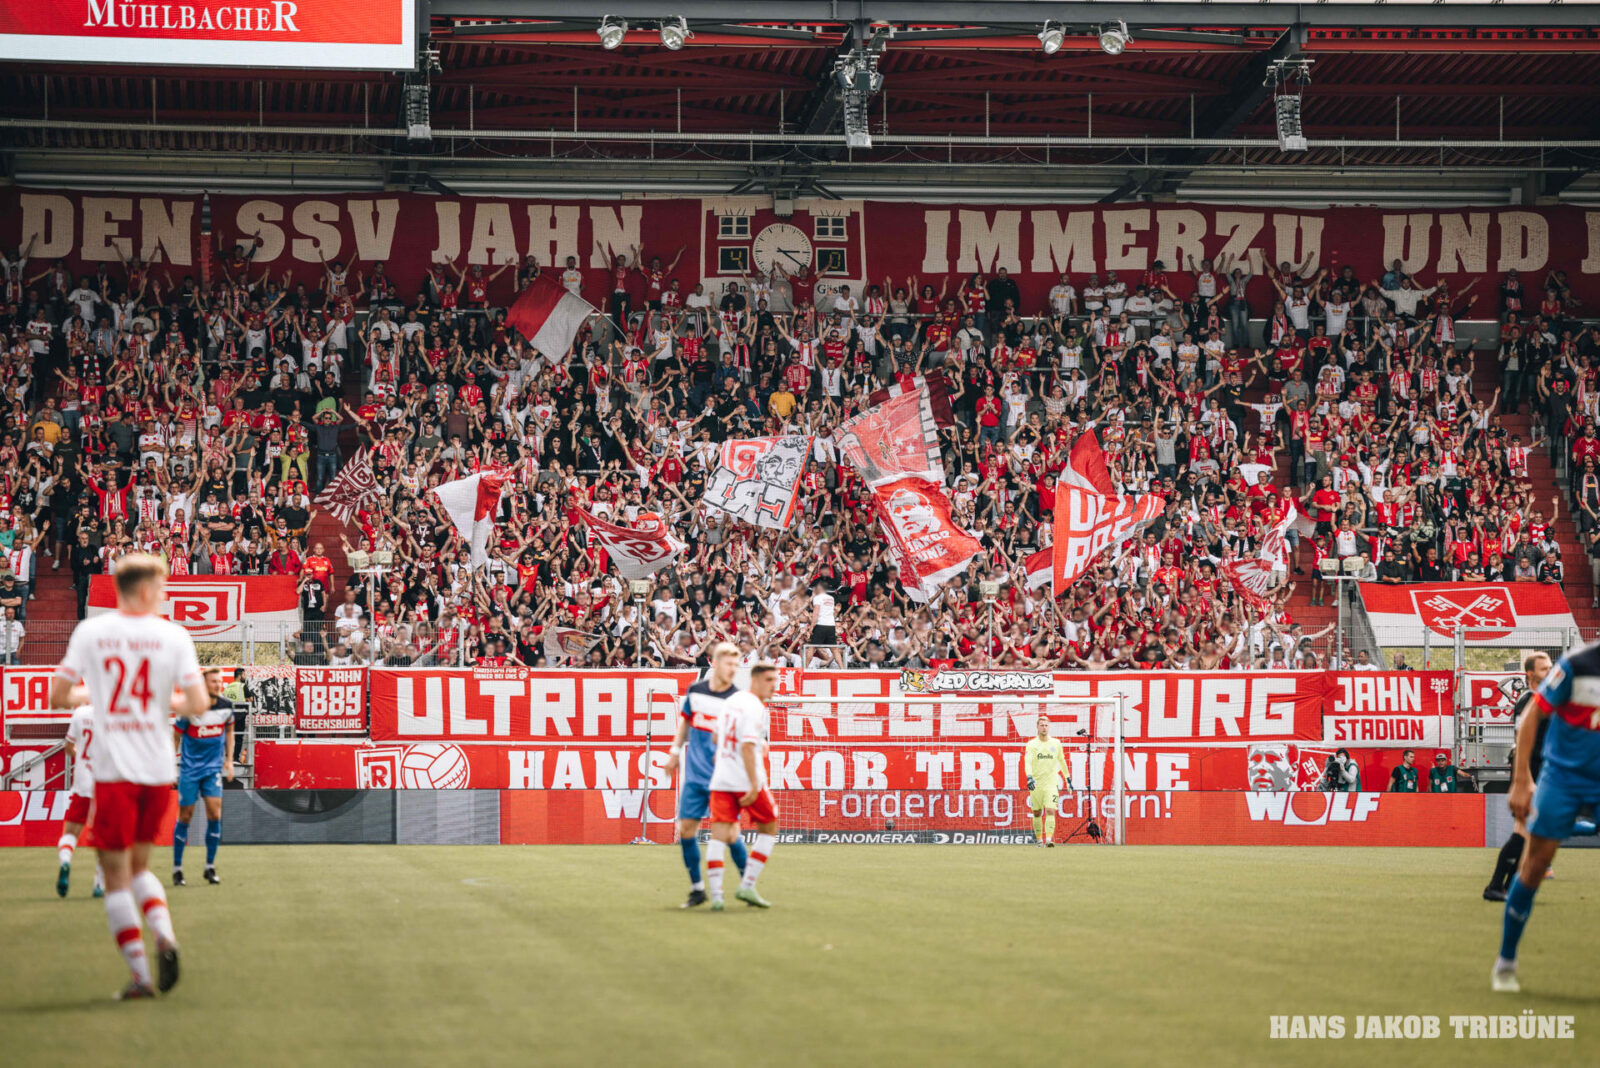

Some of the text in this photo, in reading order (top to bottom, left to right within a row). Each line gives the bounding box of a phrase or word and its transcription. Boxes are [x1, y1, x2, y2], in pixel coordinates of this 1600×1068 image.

[19, 193, 643, 269] DEN SSV JAHN
[922, 209, 1325, 279] IMMERZU
[1383, 211, 1549, 274] UND
[174, 600, 209, 621] R
[104, 656, 153, 715] 24
[300, 670, 324, 682] SSV
[329, 670, 361, 682] JAHN
[932, 672, 967, 691] RED
[300, 685, 361, 716] 1889
[397, 677, 1297, 738] ULTRAS REGENSBURG
[1334, 677, 1421, 711] JAHN
[300, 718, 361, 729] REGENSBURG
[1335, 719, 1424, 740] STADION
[508, 751, 672, 789] HANS
[1245, 792, 1381, 825] WOLF
[953, 832, 1033, 844] Dallmeier
